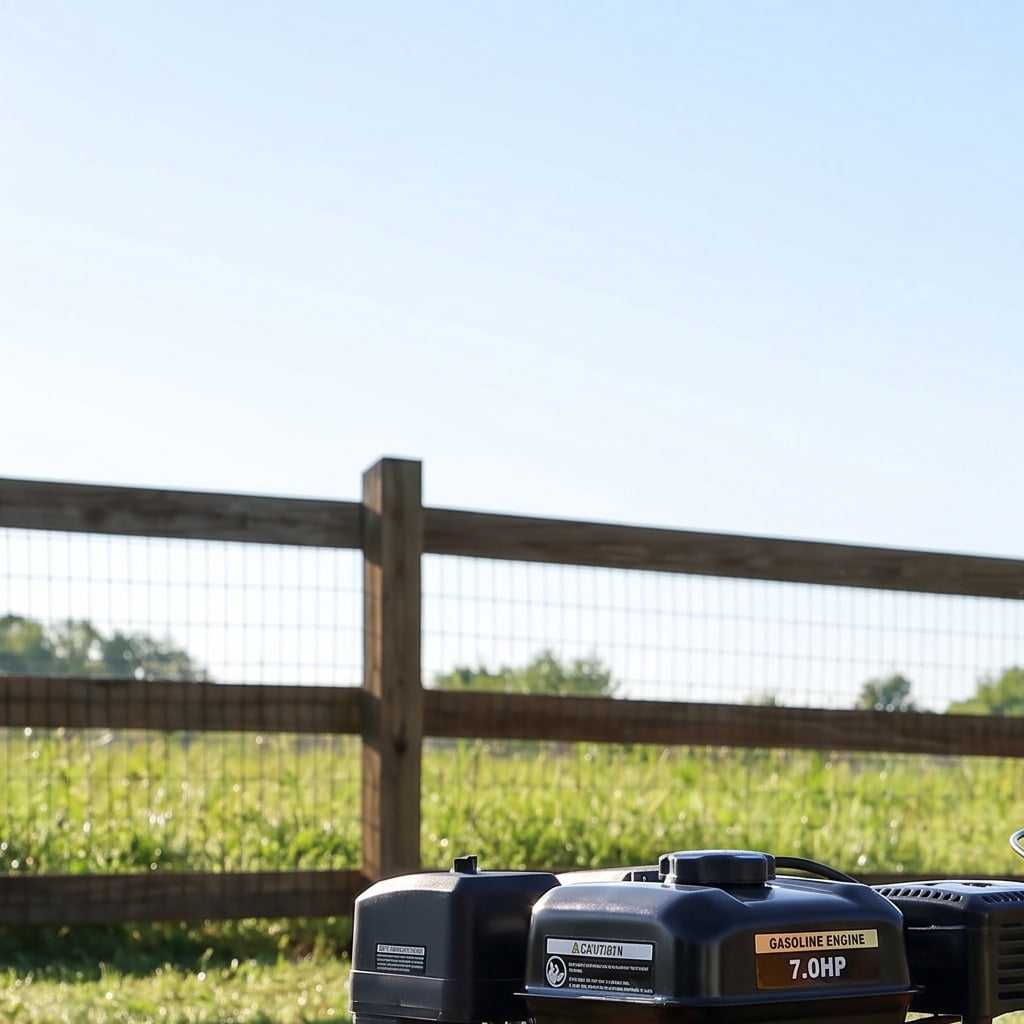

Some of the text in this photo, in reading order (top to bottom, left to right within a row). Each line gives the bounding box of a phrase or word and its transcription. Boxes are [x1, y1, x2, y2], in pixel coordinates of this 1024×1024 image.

[769, 933, 866, 950] GASOLINE ENGINE
[789, 956, 847, 980] 7.0HP
